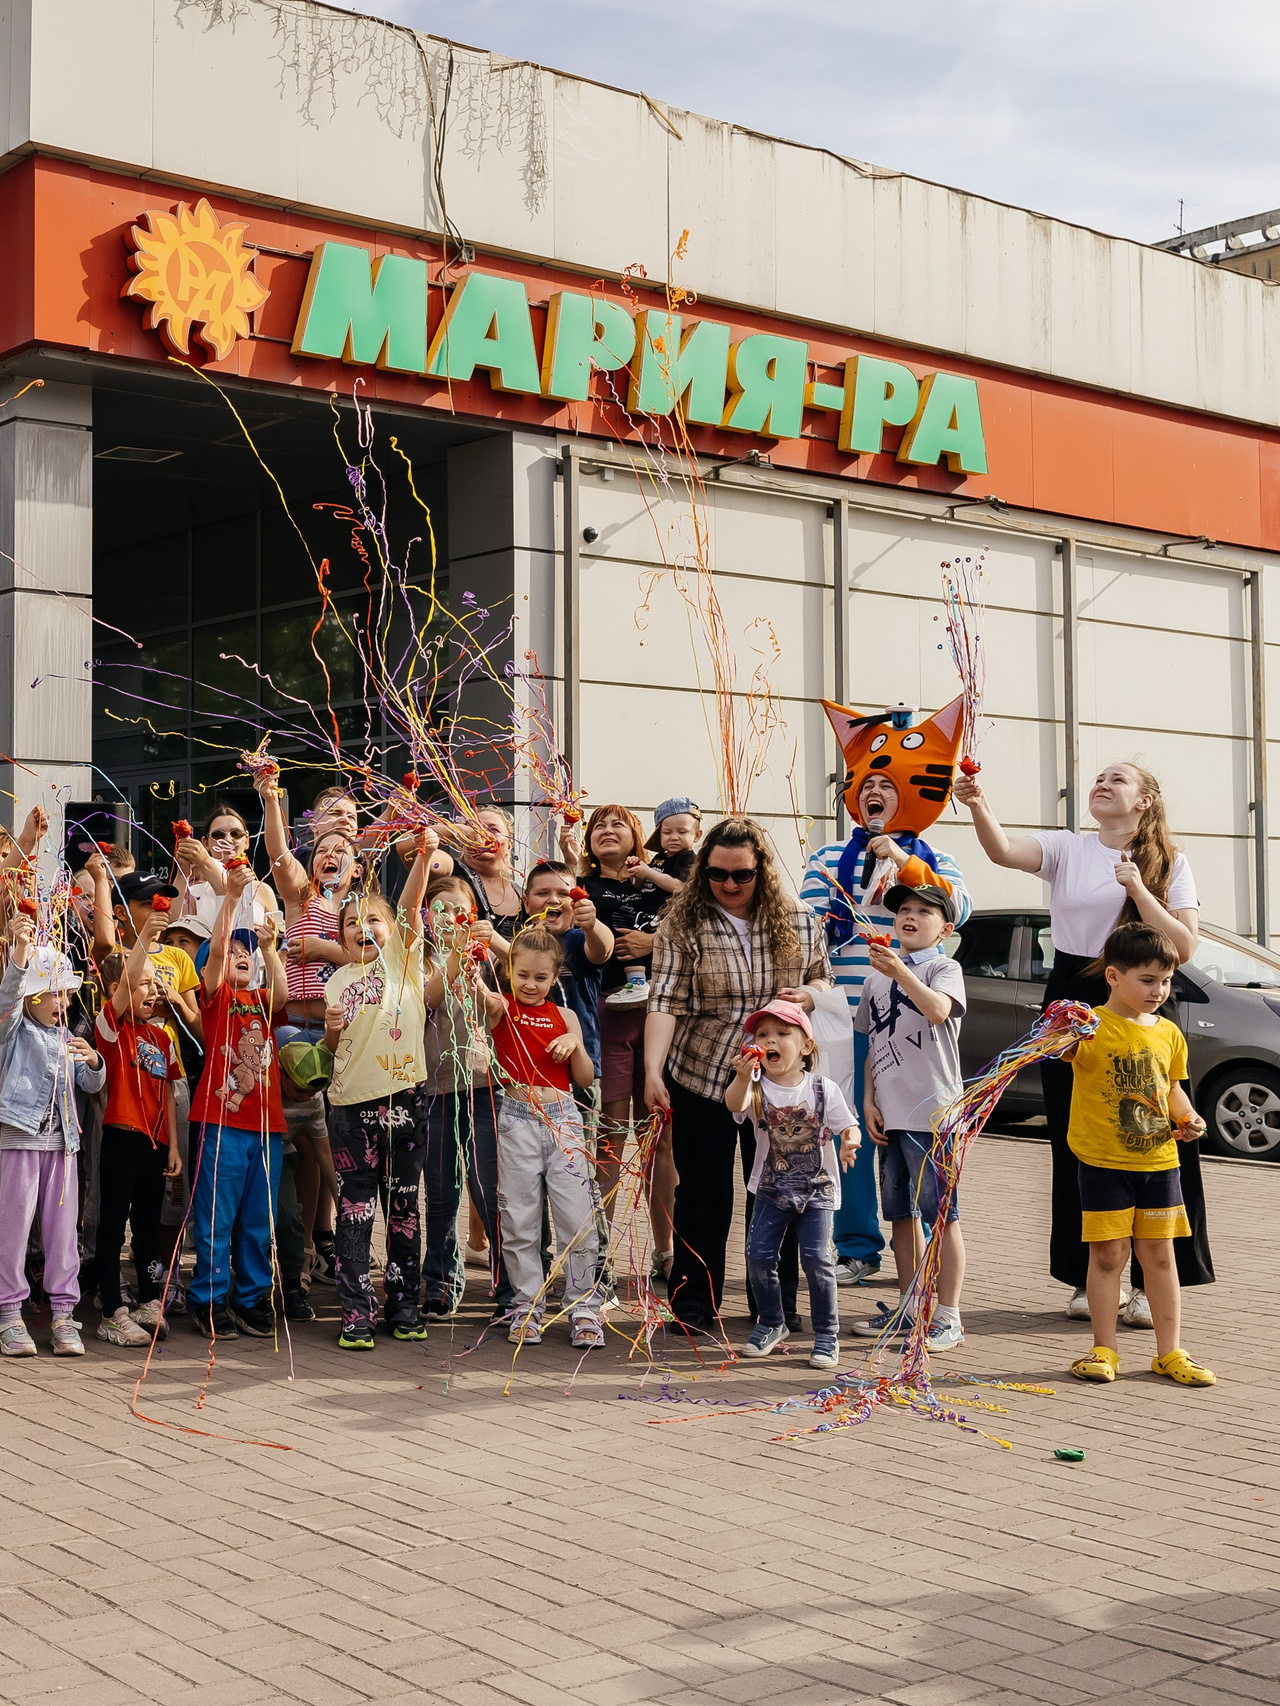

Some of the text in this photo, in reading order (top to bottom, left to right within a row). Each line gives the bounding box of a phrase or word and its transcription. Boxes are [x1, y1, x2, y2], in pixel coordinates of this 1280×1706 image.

[290, 241, 990, 476] МАРИЯ-РА
[522, 1013, 535, 1021] Se
[389, 1069, 416, 1083] TEA
